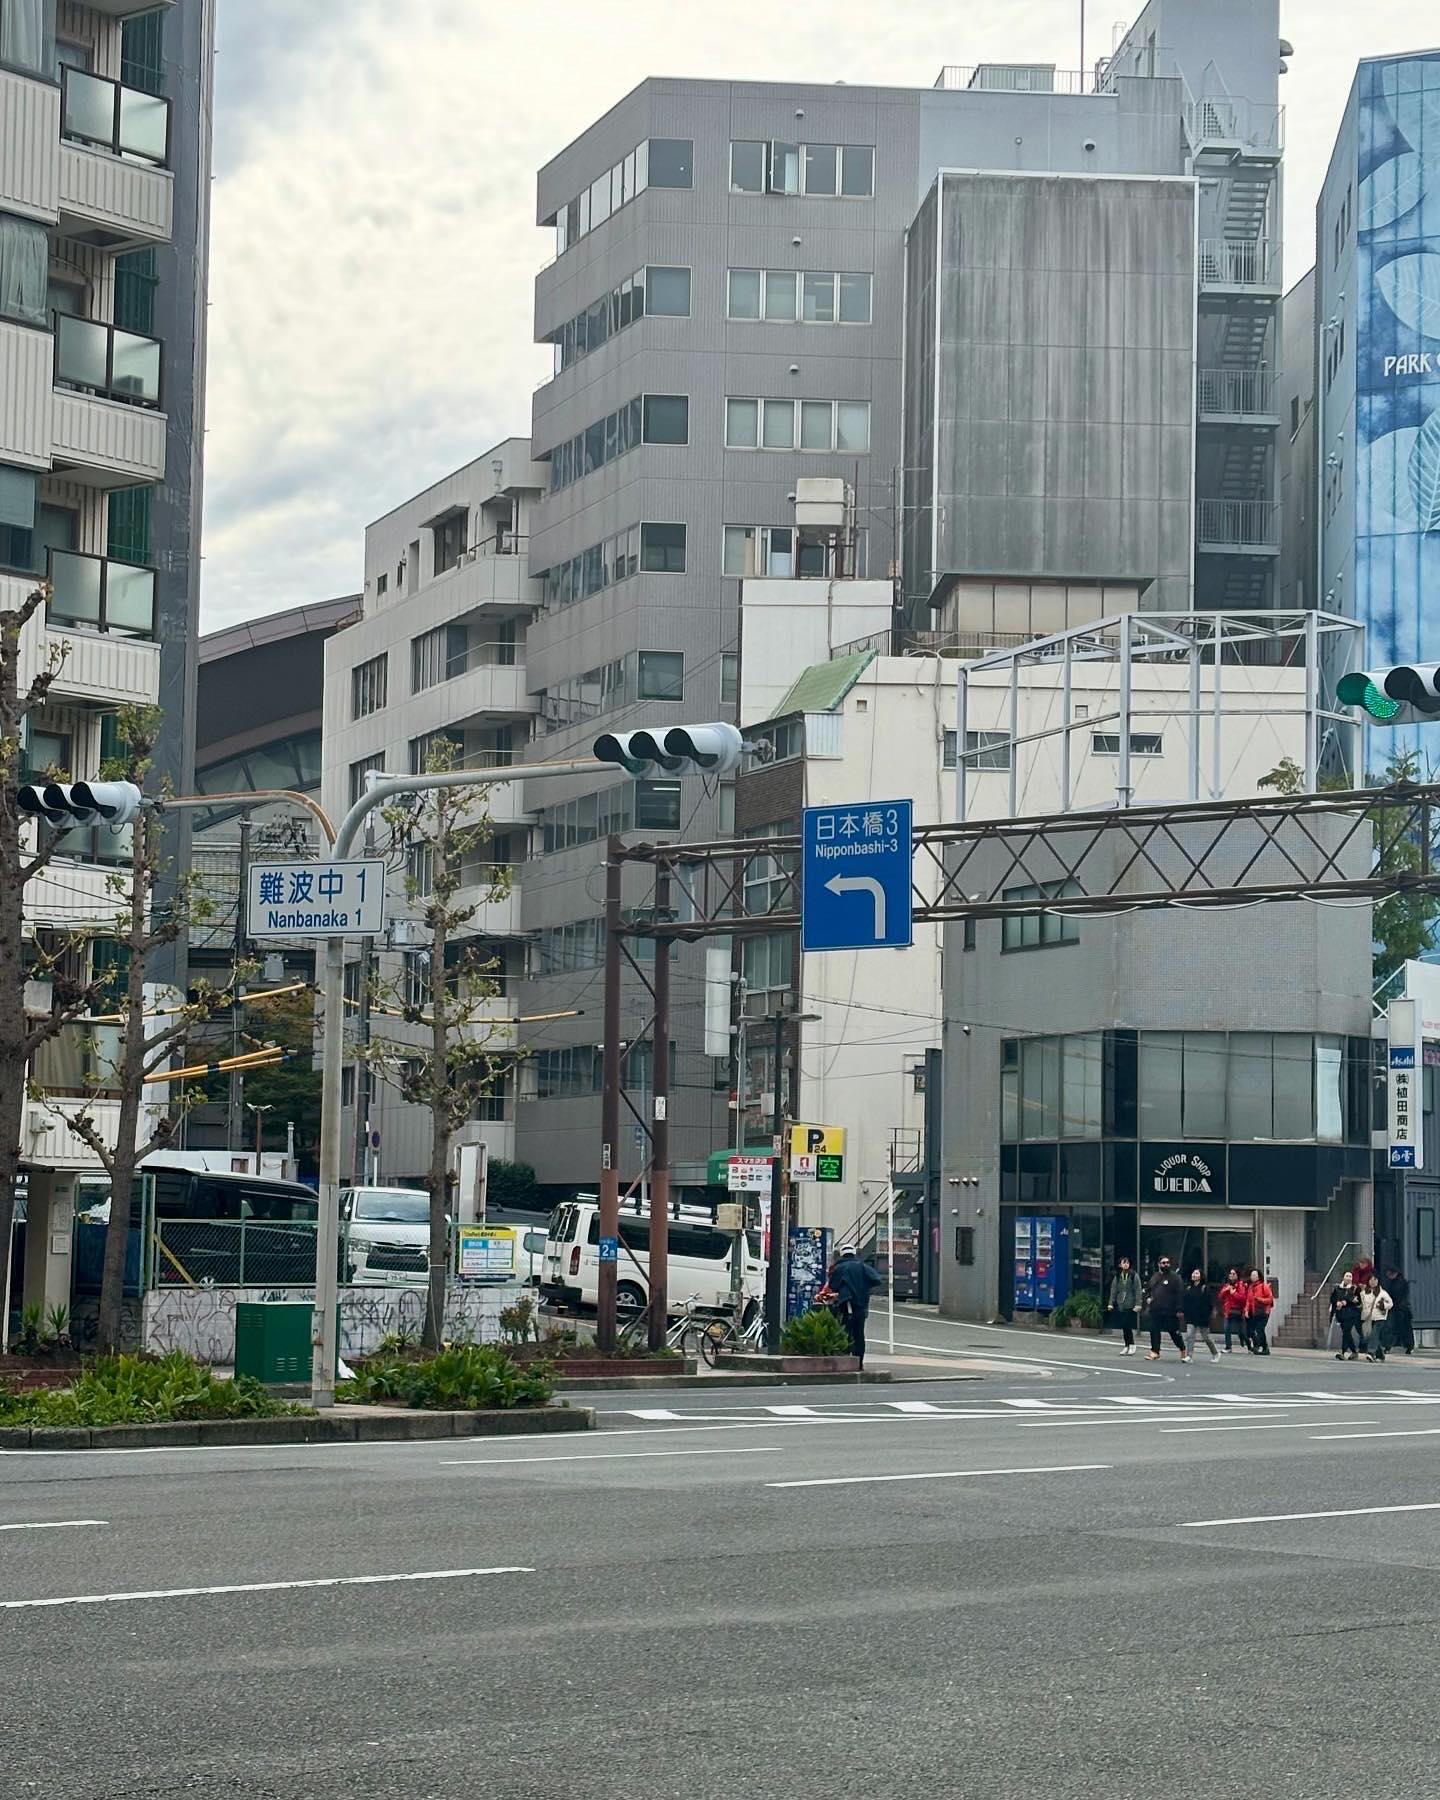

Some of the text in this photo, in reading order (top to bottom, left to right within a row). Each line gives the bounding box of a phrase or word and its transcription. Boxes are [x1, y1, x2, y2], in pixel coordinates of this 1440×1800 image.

[1384, 353, 1432, 376] PARK
[817, 809, 898, 840] 日本橋3
[815, 839, 898, 860] Nipponbashi-3
[259, 868, 366, 905] 難波中 1
[268, 908, 361, 928] Nanbanaka 1
[807, 1129, 827, 1153] P 24
[1154, 1154, 1211, 1177] LIQUOR SHOP
[1154, 1177, 1212, 1193] UEDA
